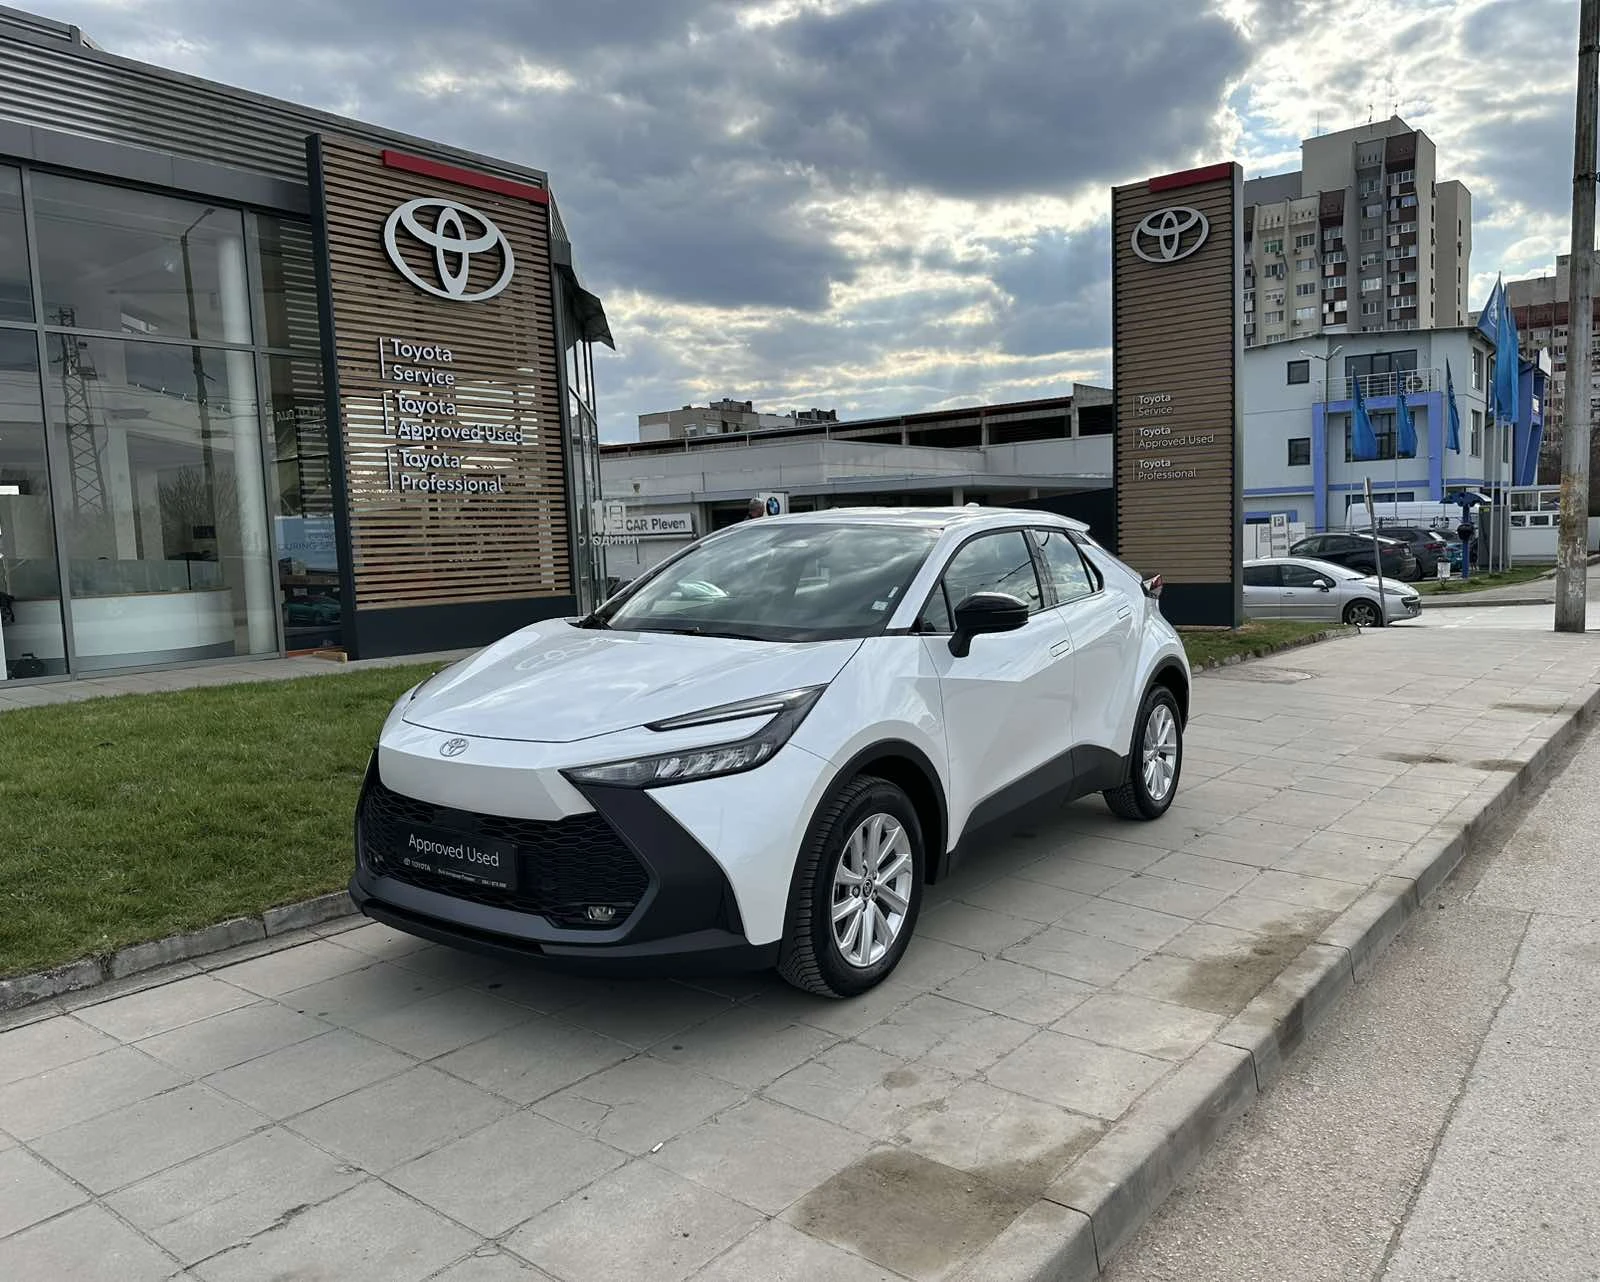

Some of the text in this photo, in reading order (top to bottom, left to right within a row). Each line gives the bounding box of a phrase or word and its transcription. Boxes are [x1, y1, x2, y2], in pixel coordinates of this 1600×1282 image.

[390, 338, 453, 362] Toyota
[393, 365, 455, 385] Service
[395, 394, 457, 417] Toyota
[1139, 393, 1171, 405] Toyota
[1139, 406, 1173, 416] Service
[398, 420, 524, 442] Approved Used
[1139, 427, 1171, 437] Toyota
[1139, 433, 1214, 449] Approved Used
[400, 450, 461, 471] Toyota
[1139, 459, 1171, 470] Toyota
[1138, 467, 1197, 480] Professional
[400, 474, 503, 493] Professional
[626, 517, 686, 532] CAR Pleven
[408, 833, 500, 868] Approved Used
